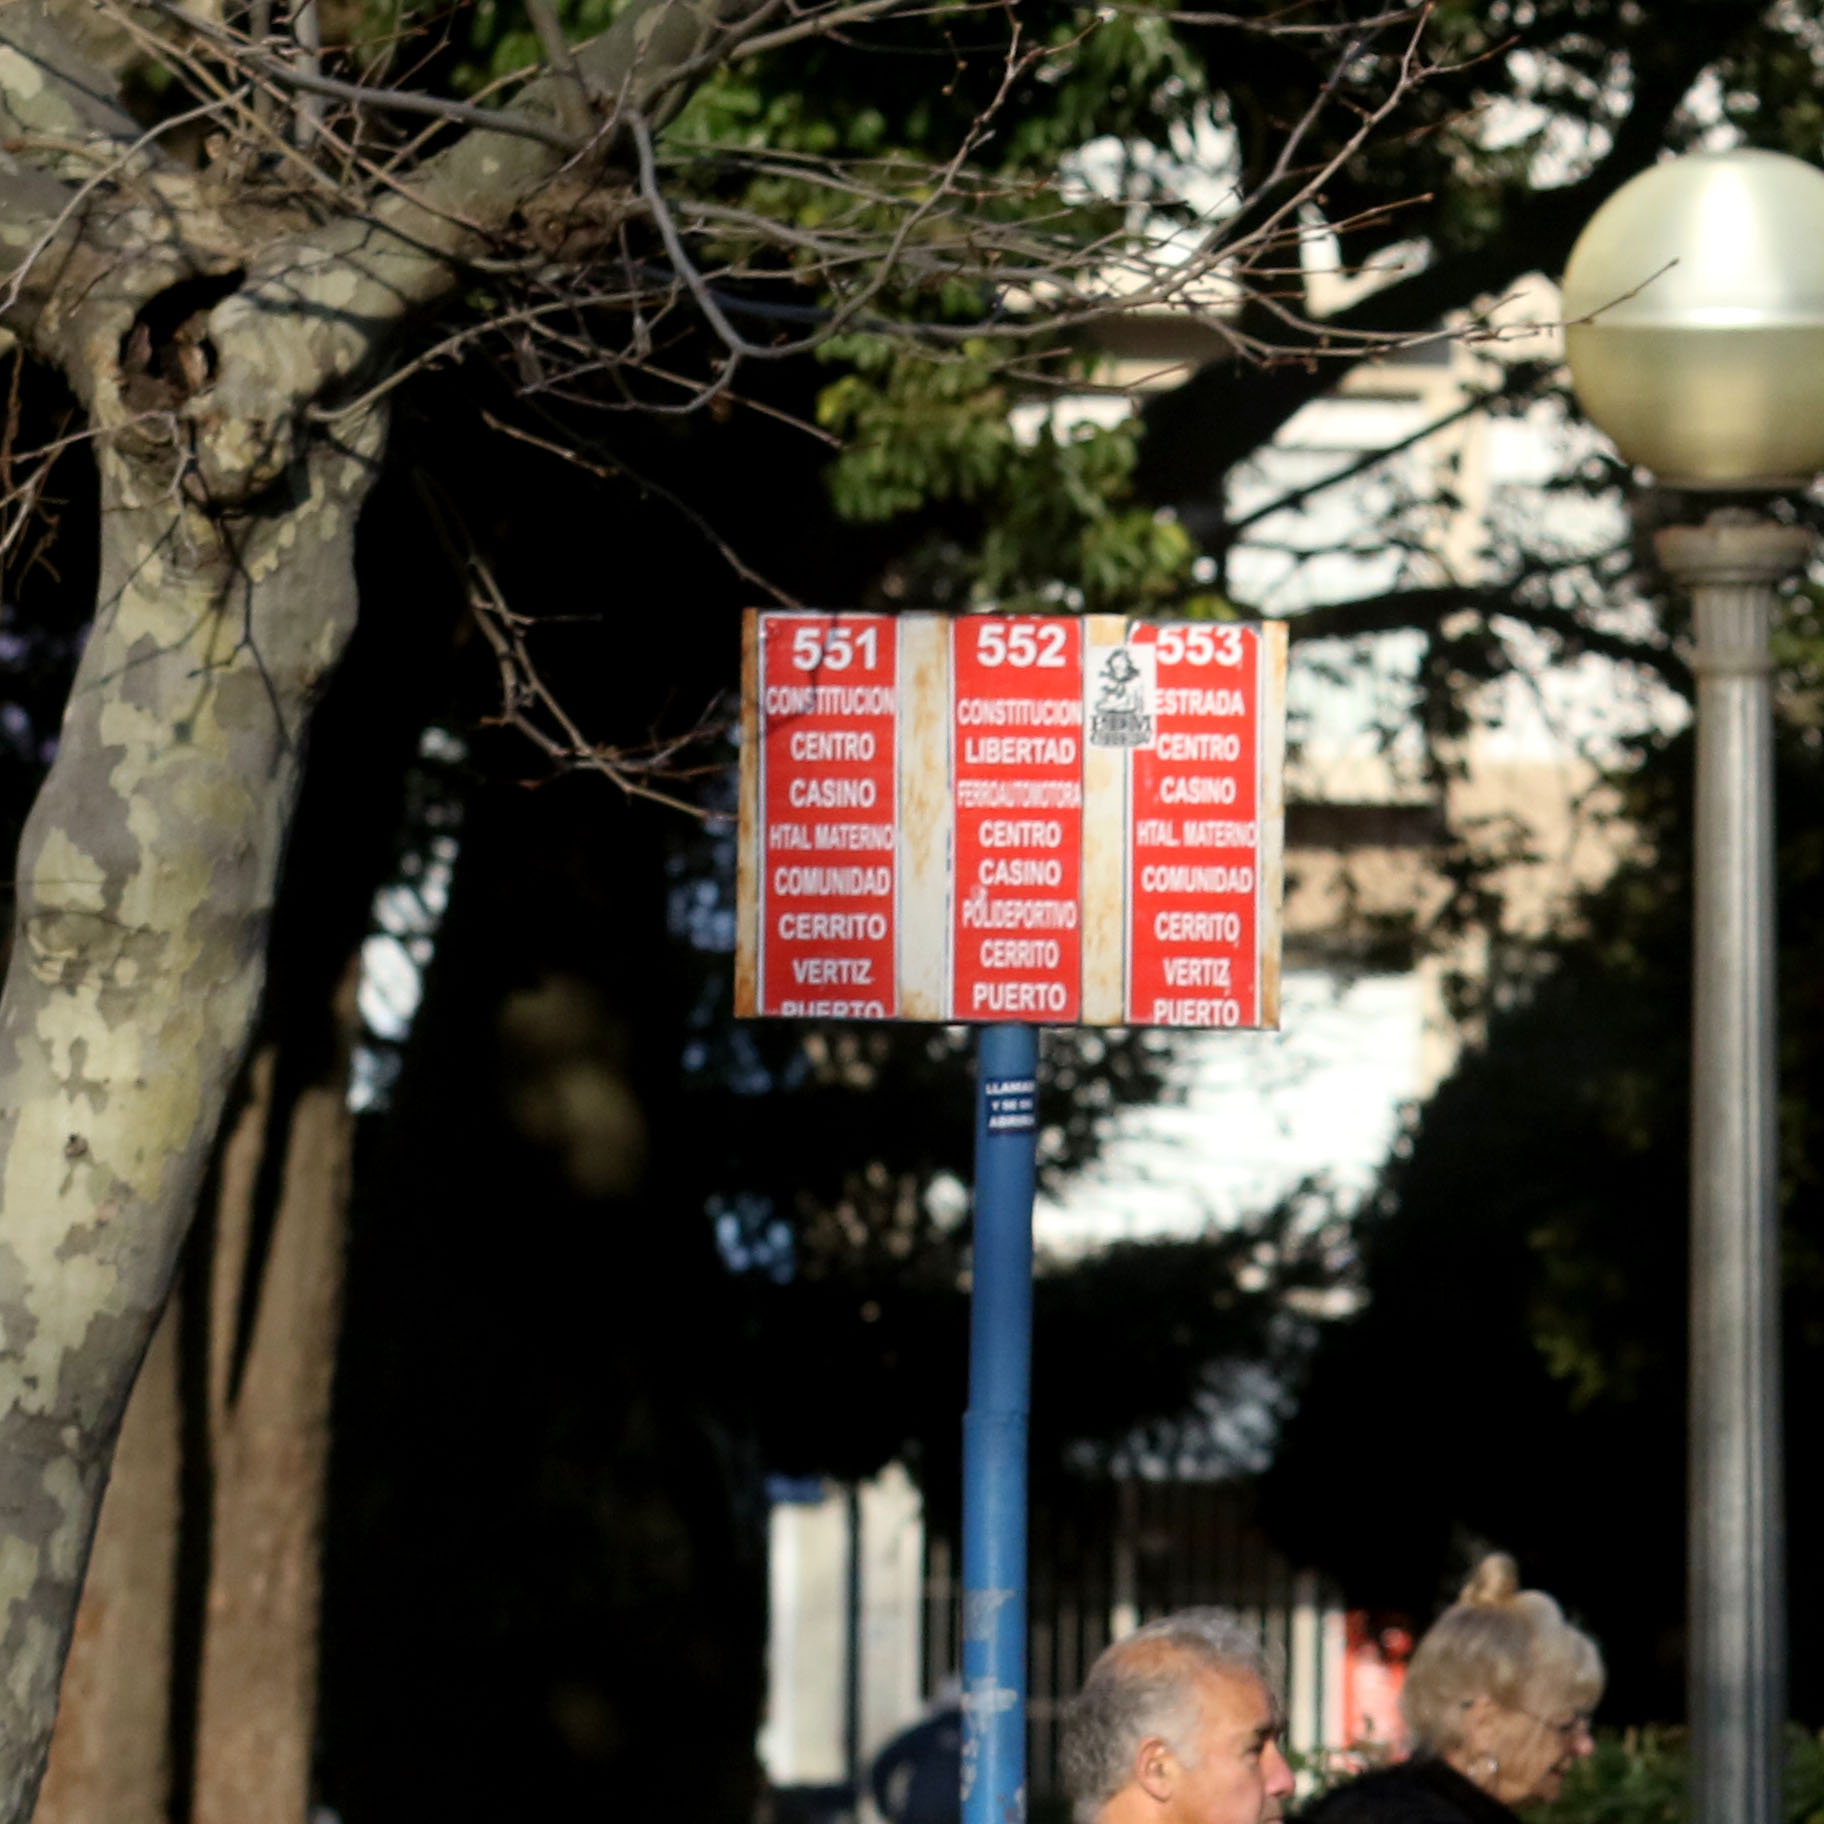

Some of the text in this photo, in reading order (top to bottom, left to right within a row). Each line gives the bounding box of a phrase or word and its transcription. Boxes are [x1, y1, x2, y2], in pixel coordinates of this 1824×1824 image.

[792, 626, 878, 671] 551
[976, 623, 1067, 668] 552
[1156, 624, 1243, 666] 553
[767, 686, 897, 715] CONSTITUCION
[958, 699, 1083, 726] CONSTITUCION
[1152, 688, 1246, 715] ESTRADA
[790, 731, 876, 761] CENTRO
[965, 737, 1076, 765] LIBERTAD
[1156, 733, 1240, 761] CENTRO
[789, 778, 877, 808] CASINO
[1160, 776, 1237, 804] CASINO
[814, 823, 894, 850] MATERNO
[979, 820, 1062, 848] CENTRO
[1182, 820, 1257, 848] MATERNO
[774, 866, 891, 896] COMUNIDAD
[978, 858, 1062, 886] CASINO
[1141, 865, 1254, 893] COMUNIDAD
[778, 912, 887, 941] CERRITO
[962, 899, 1077, 929] POLIDEPORTIVO
[1154, 911, 1241, 942] CERRITO
[980, 939, 1060, 968] CERRITO
[791, 958, 873, 985] VERTIZ
[1162, 957, 1231, 987] VERTIZ
[973, 982, 1067, 1011] PUERTO
[1153, 998, 1240, 1025] PUERTO
